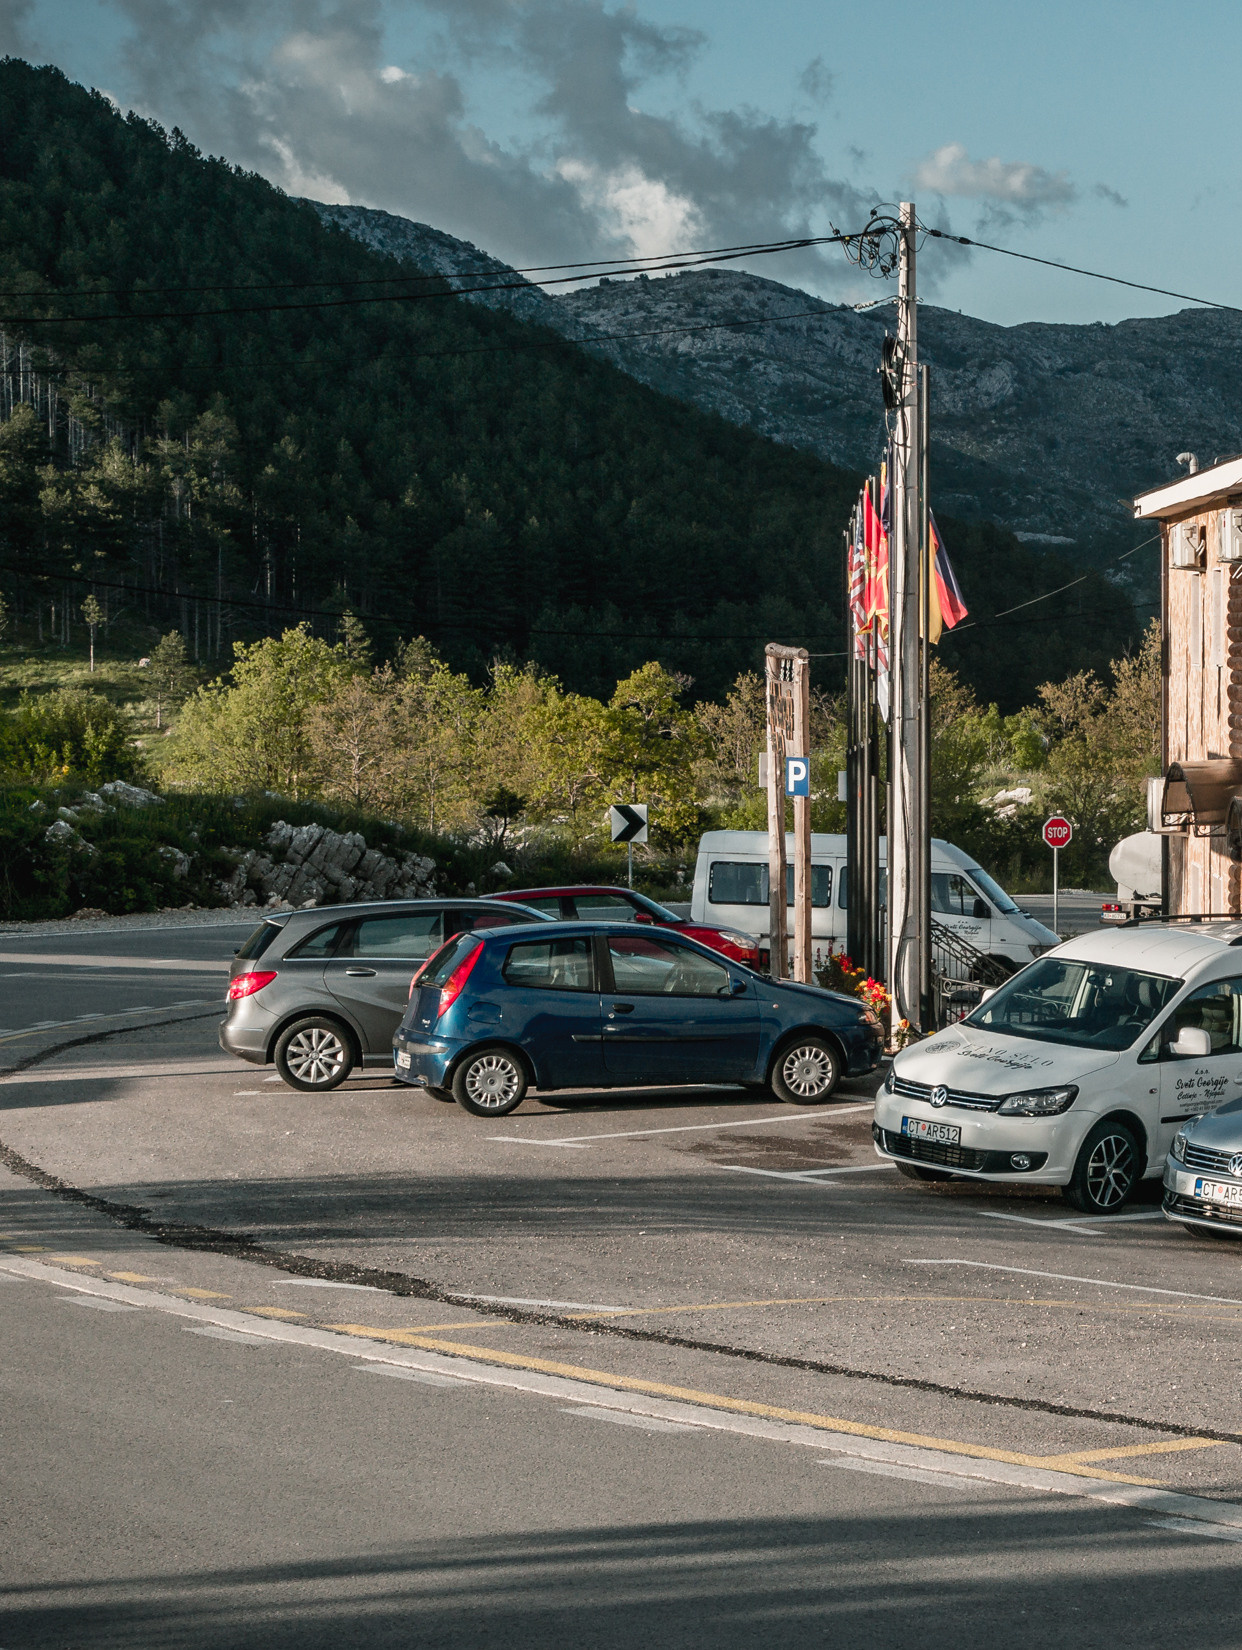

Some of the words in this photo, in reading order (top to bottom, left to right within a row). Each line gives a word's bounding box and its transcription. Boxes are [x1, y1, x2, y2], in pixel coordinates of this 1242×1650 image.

[788, 760, 807, 793] P
[1047, 826, 1068, 839] STOP
[1175, 1078, 1195, 1090] Sveti
[1196, 1076, 1230, 1091] Georgije
[908, 1120, 921, 1134] CT
[926, 1124, 958, 1142] AR512
[1203, 1183, 1217, 1197] CT
